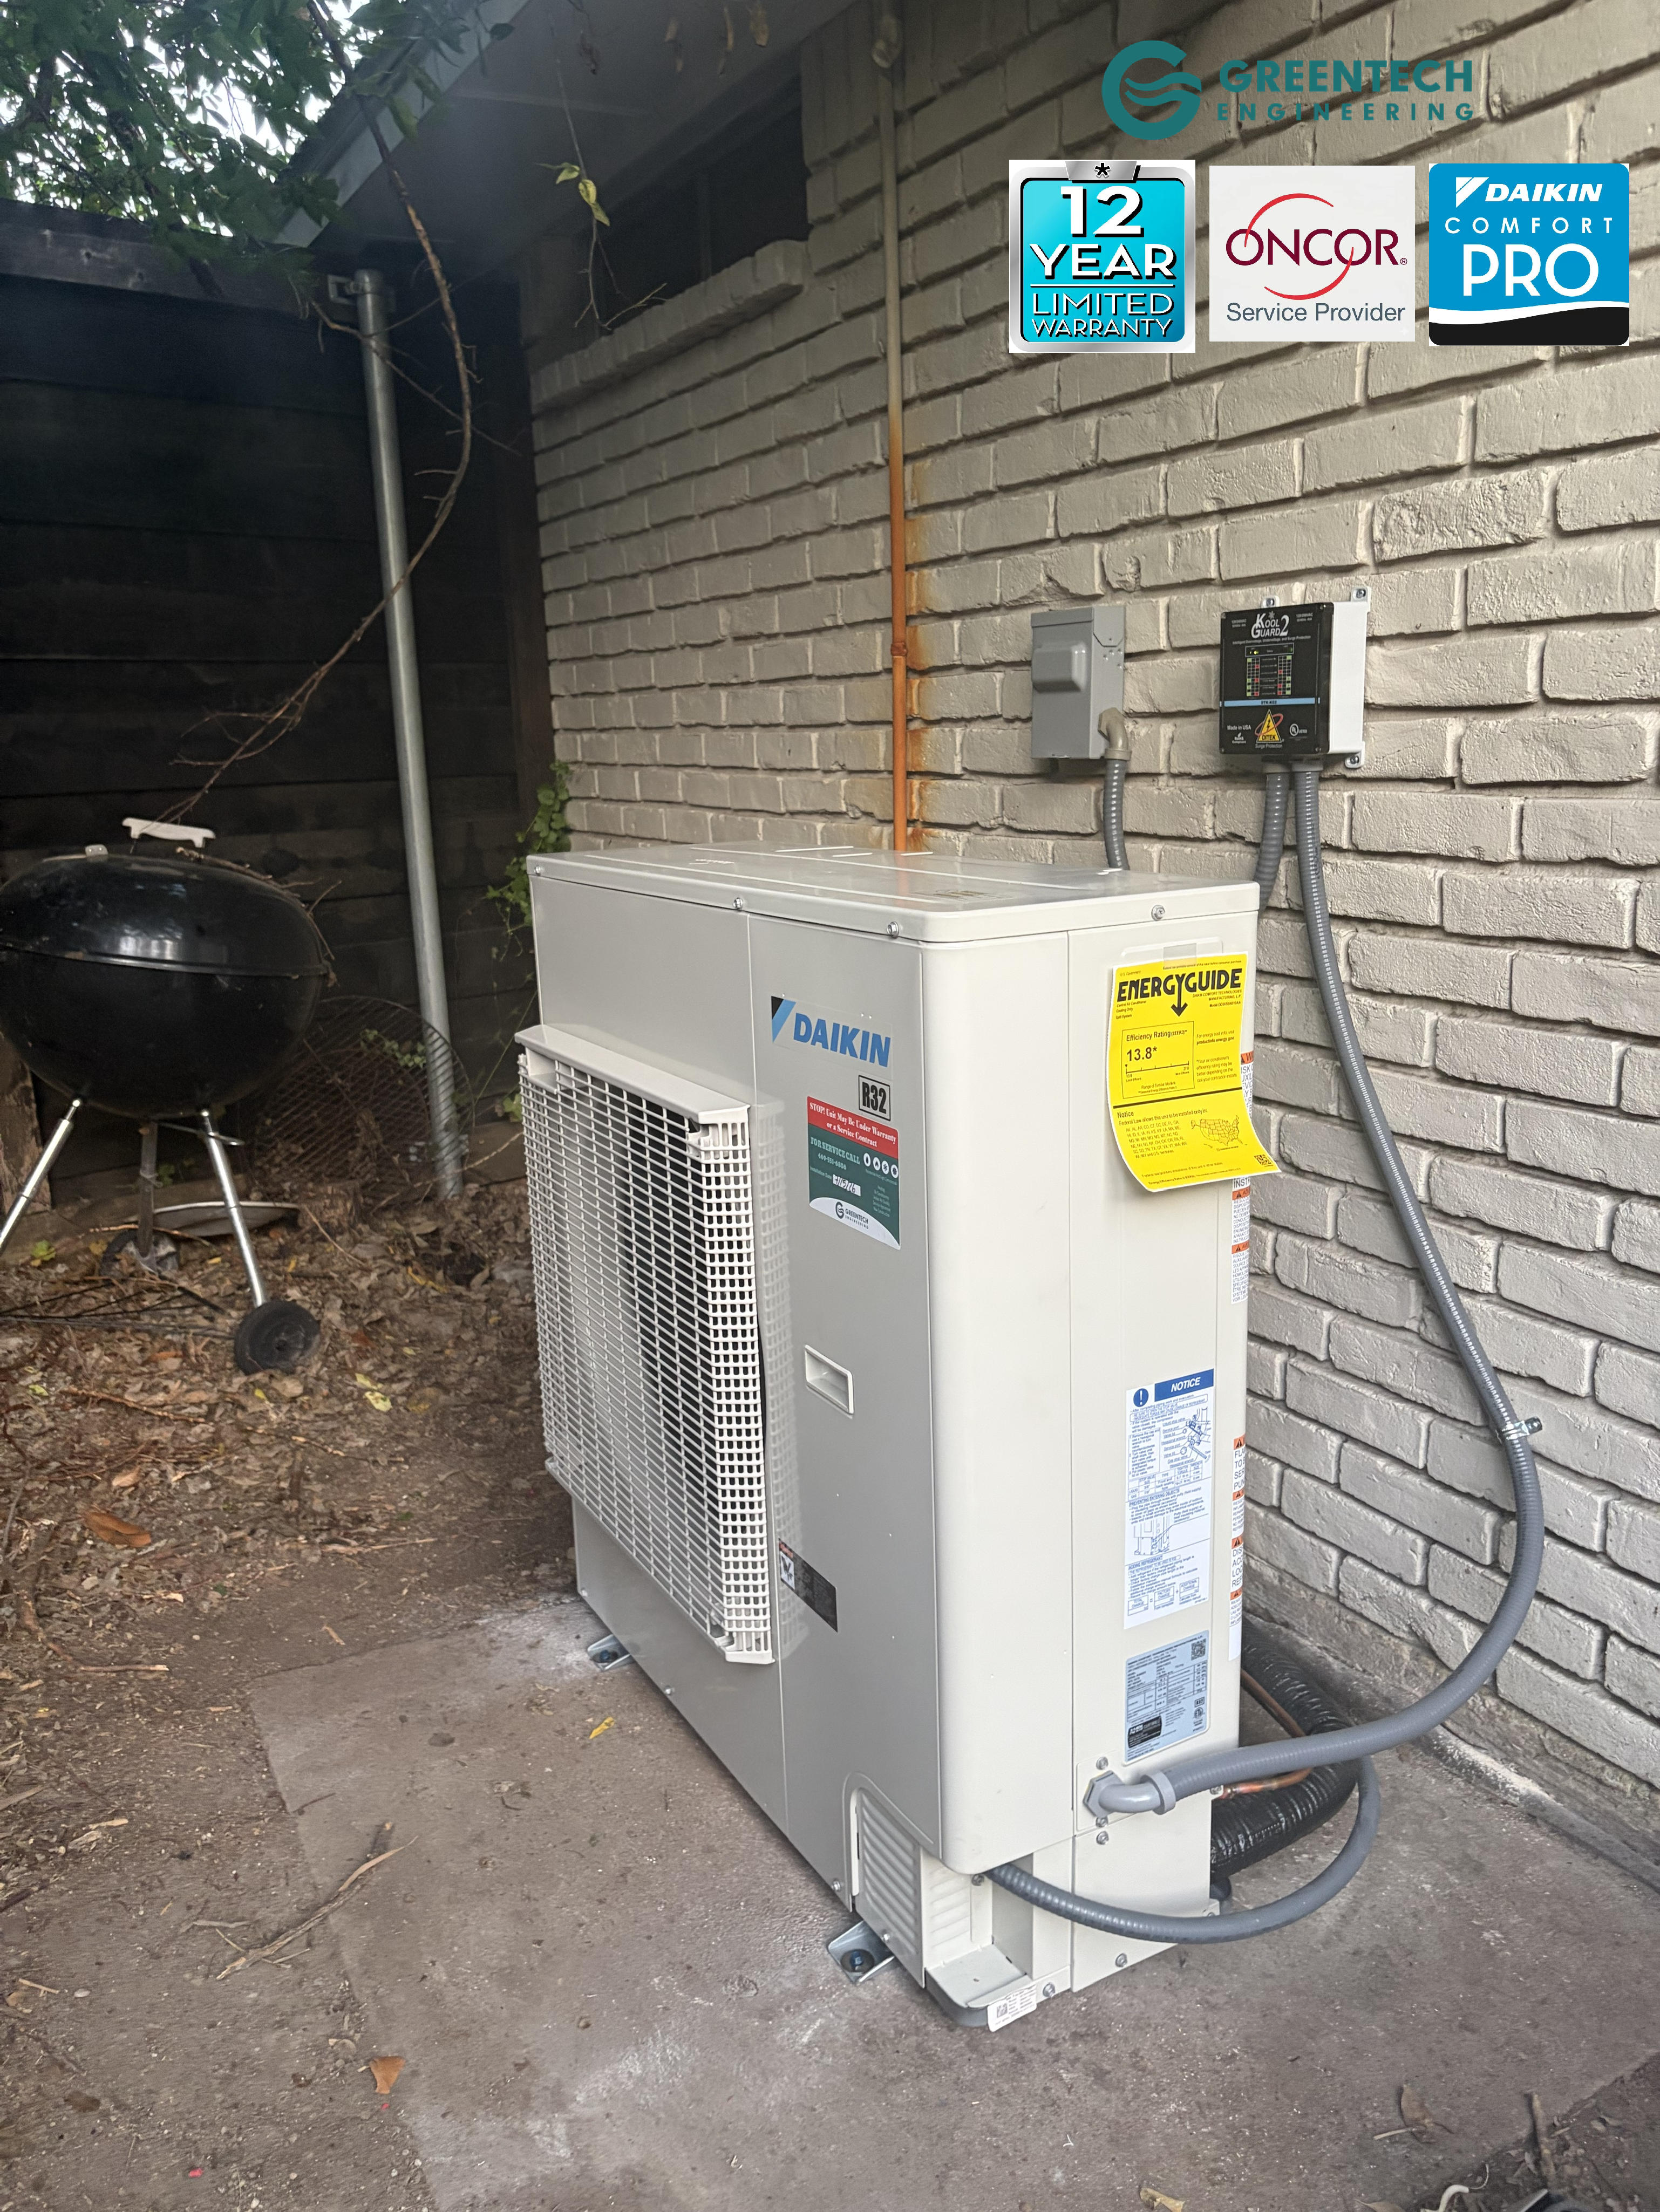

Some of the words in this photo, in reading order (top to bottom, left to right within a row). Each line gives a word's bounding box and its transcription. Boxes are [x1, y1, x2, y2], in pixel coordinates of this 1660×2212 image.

[1251, 623, 1281, 639] GUARD
[1280, 615, 1290, 637] 2
[1117, 968, 1242, 1002] ENERGYGUIDE
[793, 1013, 891, 1068] DAIKIN
[1126, 1032, 1152, 1042] Efficiency
[862, 1081, 887, 1114] R32
[809, 1102, 825, 1115] STOP!
[826, 1108, 836, 1119] Unit
[837, 1112, 847, 1125] May
[848, 1117, 855, 1126] Be
[856, 1120, 871, 1132] Under
[872, 1126, 896, 1145] Warranty
[1117, 1110, 1134, 1118] Notice
[837, 1124, 854, 1138] Service
[855, 1131, 877, 1148] Contract
[811, 1137, 821, 1148] FOR
[822, 1141, 845, 1158] SERVICE
[846, 1152, 860, 1165] CALL
[845, 1208, 869, 1224] GREENTECH
[1171, 1377, 1201, 1392] NOTICE
